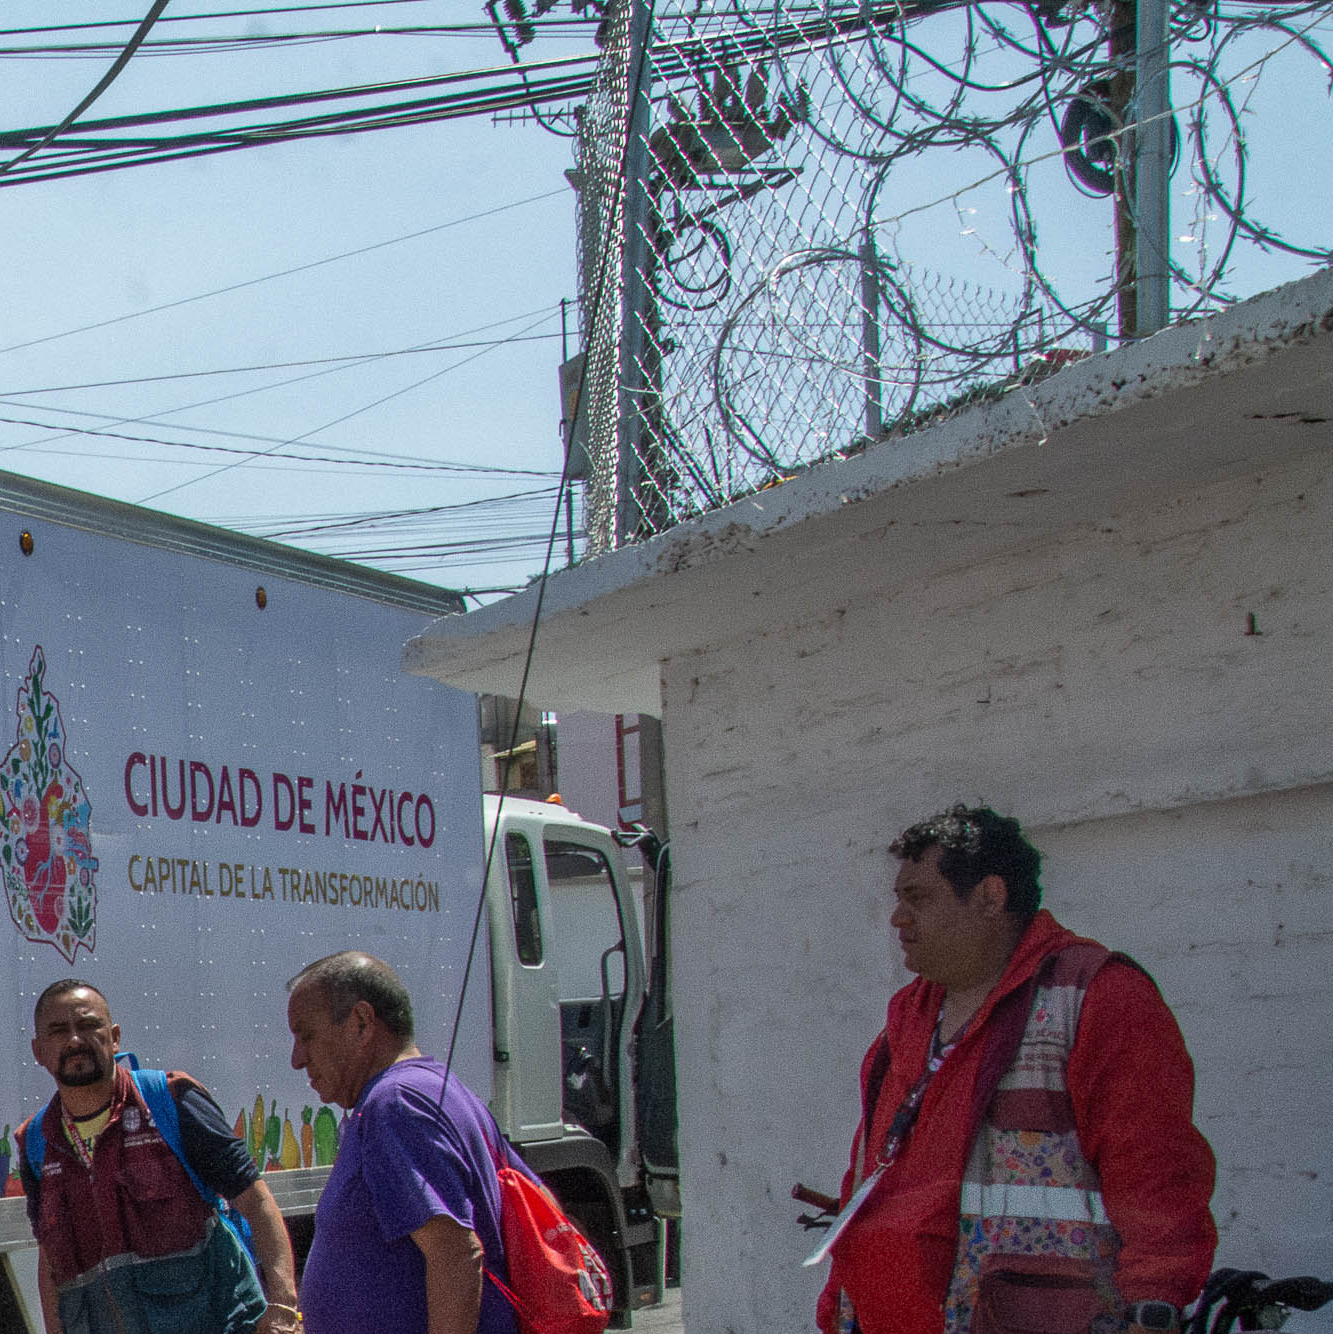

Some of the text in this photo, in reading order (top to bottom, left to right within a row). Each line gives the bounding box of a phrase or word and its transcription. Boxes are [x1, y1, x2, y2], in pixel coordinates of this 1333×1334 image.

[124, 752, 436, 848] CIUDAD DE MÉXICO
[128, 855, 440, 912] CAPITAL DE LA TRANSFORMACIÓN
